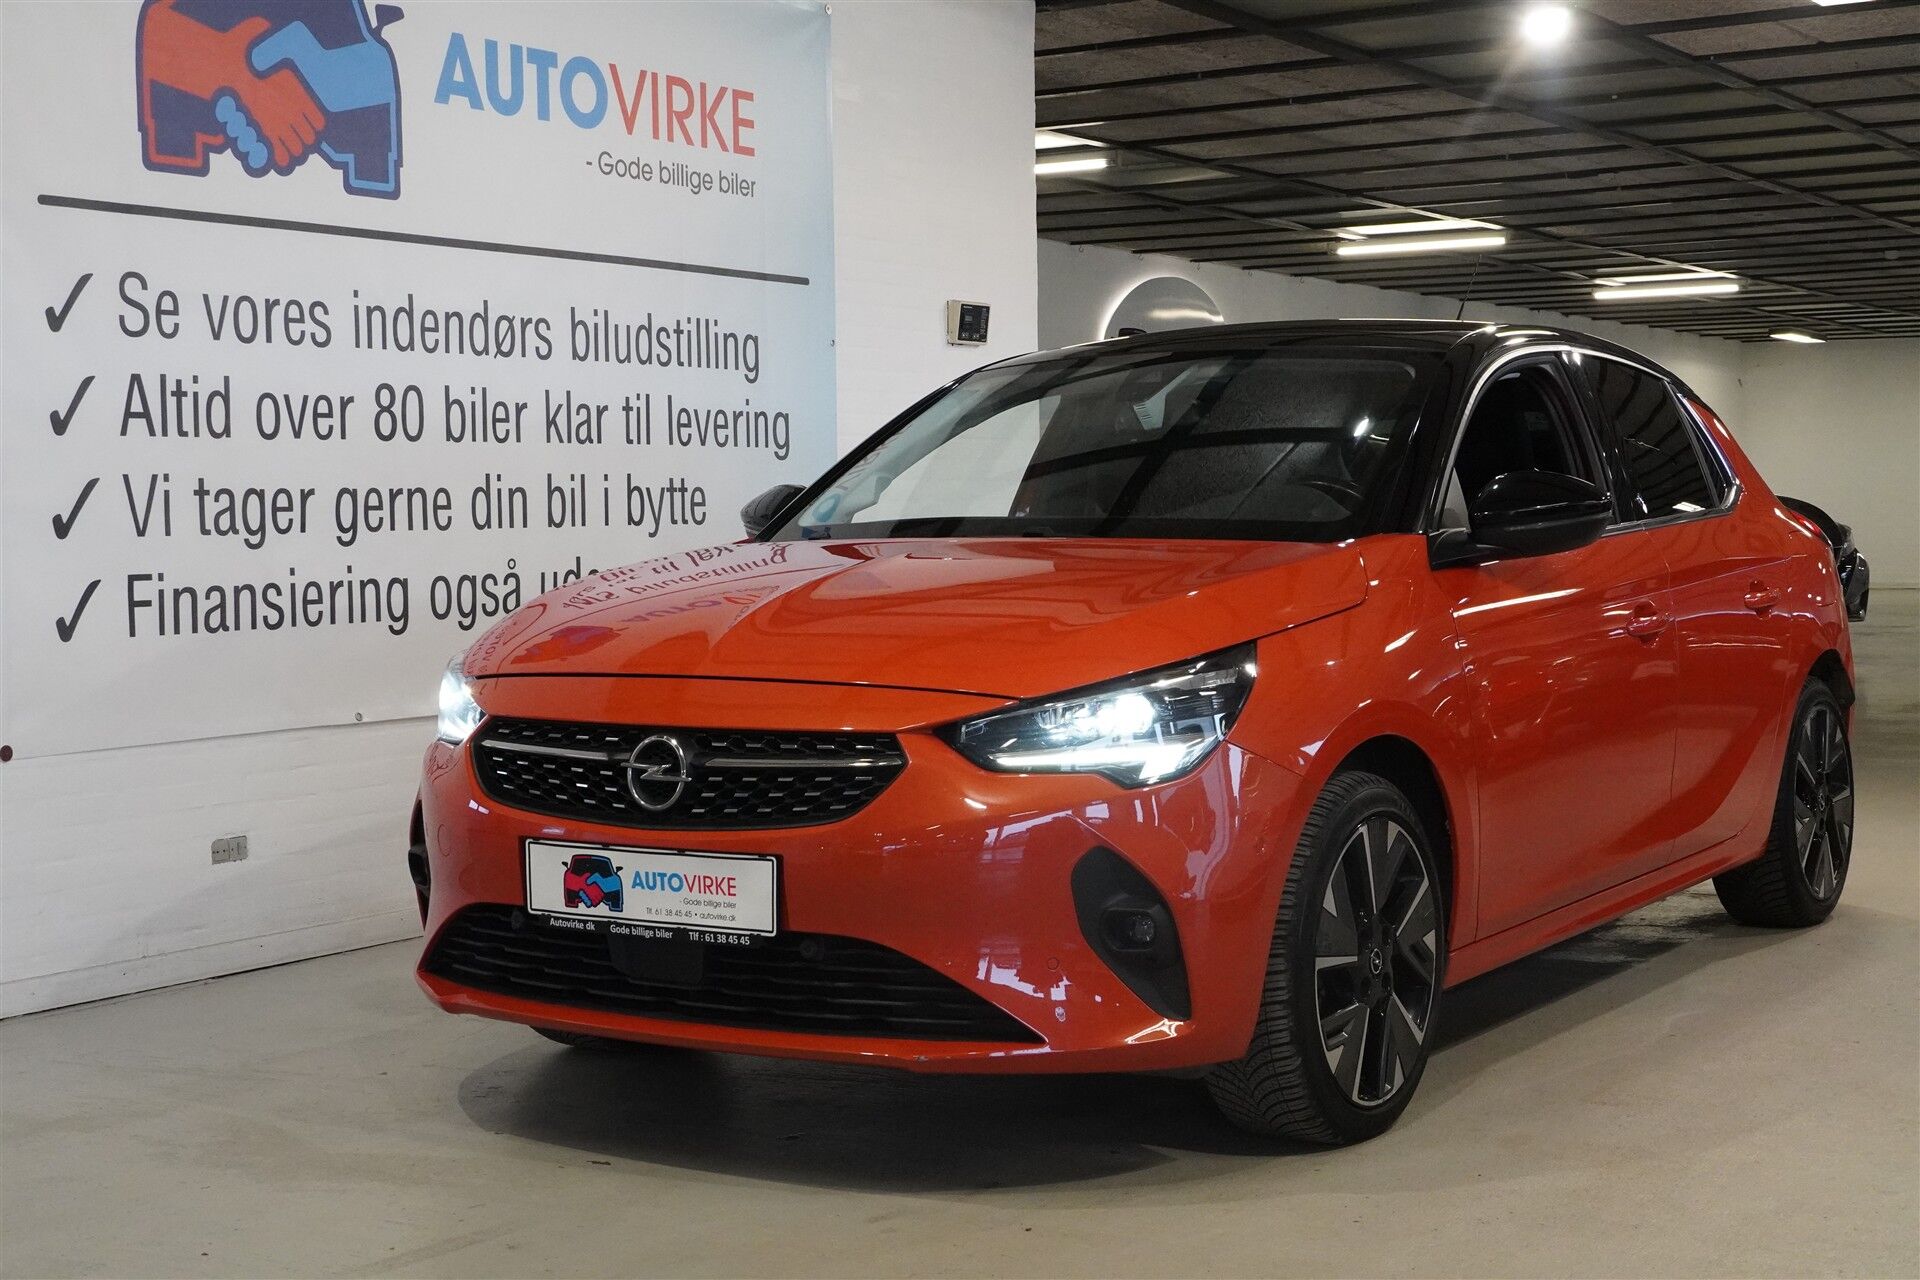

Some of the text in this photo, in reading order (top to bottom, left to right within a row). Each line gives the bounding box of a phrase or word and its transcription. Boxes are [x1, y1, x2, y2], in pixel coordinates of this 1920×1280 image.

[434, 32, 756, 157] AUTOVIRKE
[598, 151, 653, 182] Gode
[658, 162, 714, 195] billige
[719, 171, 756, 198] biler
[118, 271, 761, 385] Se vores indendørs biludstilling
[120, 374, 791, 461] Altid over 80 biler klar til levering
[122, 473, 707, 551] Vi tager gerne din bil i bytte
[127, 565, 410, 638] Finansiering
[429, 558, 521, 632] også
[631, 870, 737, 897] AUTOVIRKE
[683, 897, 702, 906] Gode
[549, 917, 596, 931] Autovirke dk
[609, 924, 673, 939] Gode billige biler
[664, 908, 673, 917] 38
[684, 910, 693, 918] 45
[704, 933, 715, 943] 61
[716, 934, 727, 944] 38
[728, 935, 739, 945] 45
[739, 936, 750, 946] 45
